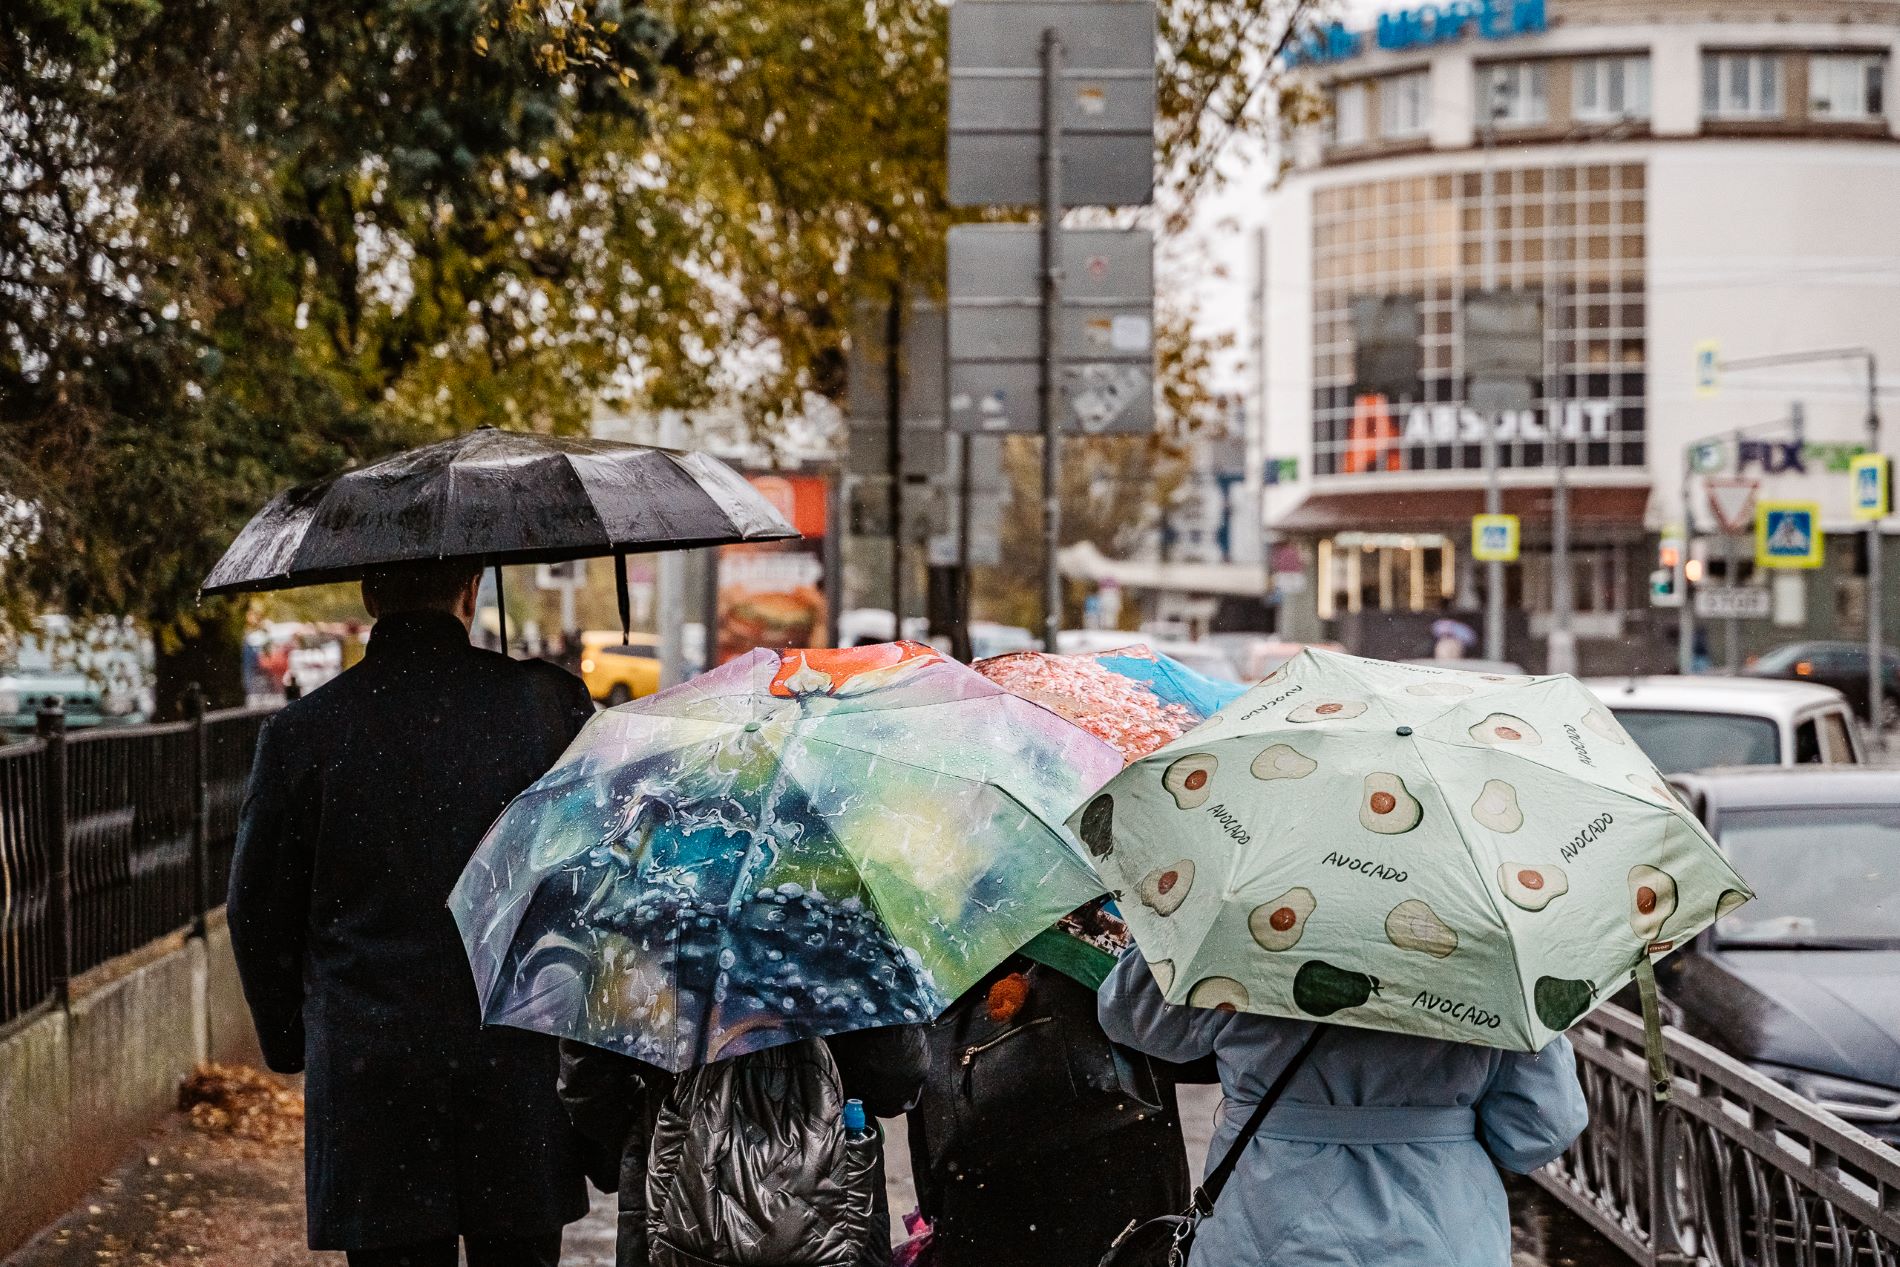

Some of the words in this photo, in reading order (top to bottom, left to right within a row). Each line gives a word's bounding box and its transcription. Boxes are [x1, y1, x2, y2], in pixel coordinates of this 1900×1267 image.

[1206, 804, 1251, 845] AVOCADO
[1560, 812, 1614, 864] AVOCADO
[1321, 851, 1408, 883] AVOCADO
[1411, 990, 1501, 1029] AVOCADO
